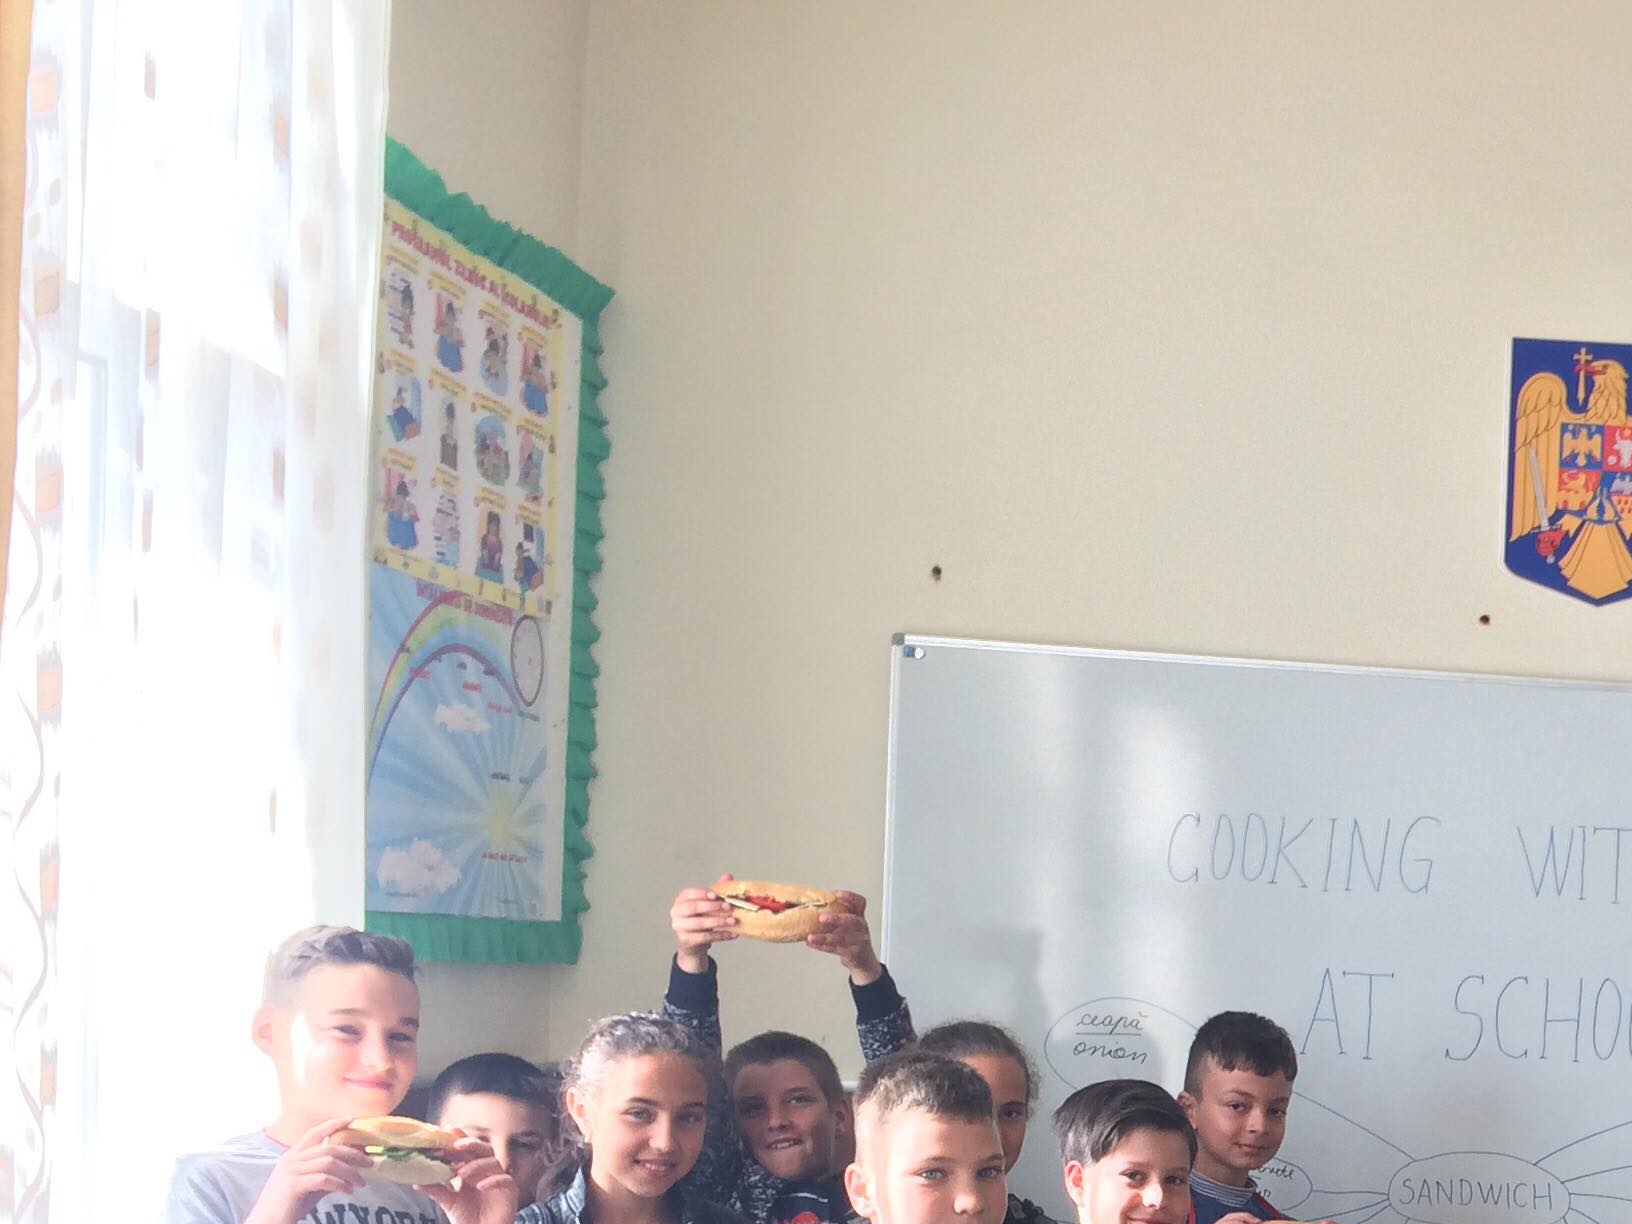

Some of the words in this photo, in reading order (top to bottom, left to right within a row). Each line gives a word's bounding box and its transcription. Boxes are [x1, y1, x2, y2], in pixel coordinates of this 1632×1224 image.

[1167, 811, 1443, 894] COOKING
[1300, 967, 1395, 1060] AT
[1072, 1040, 1148, 1065] onion
[1400, 1177, 1553, 1211] SANDWICH
